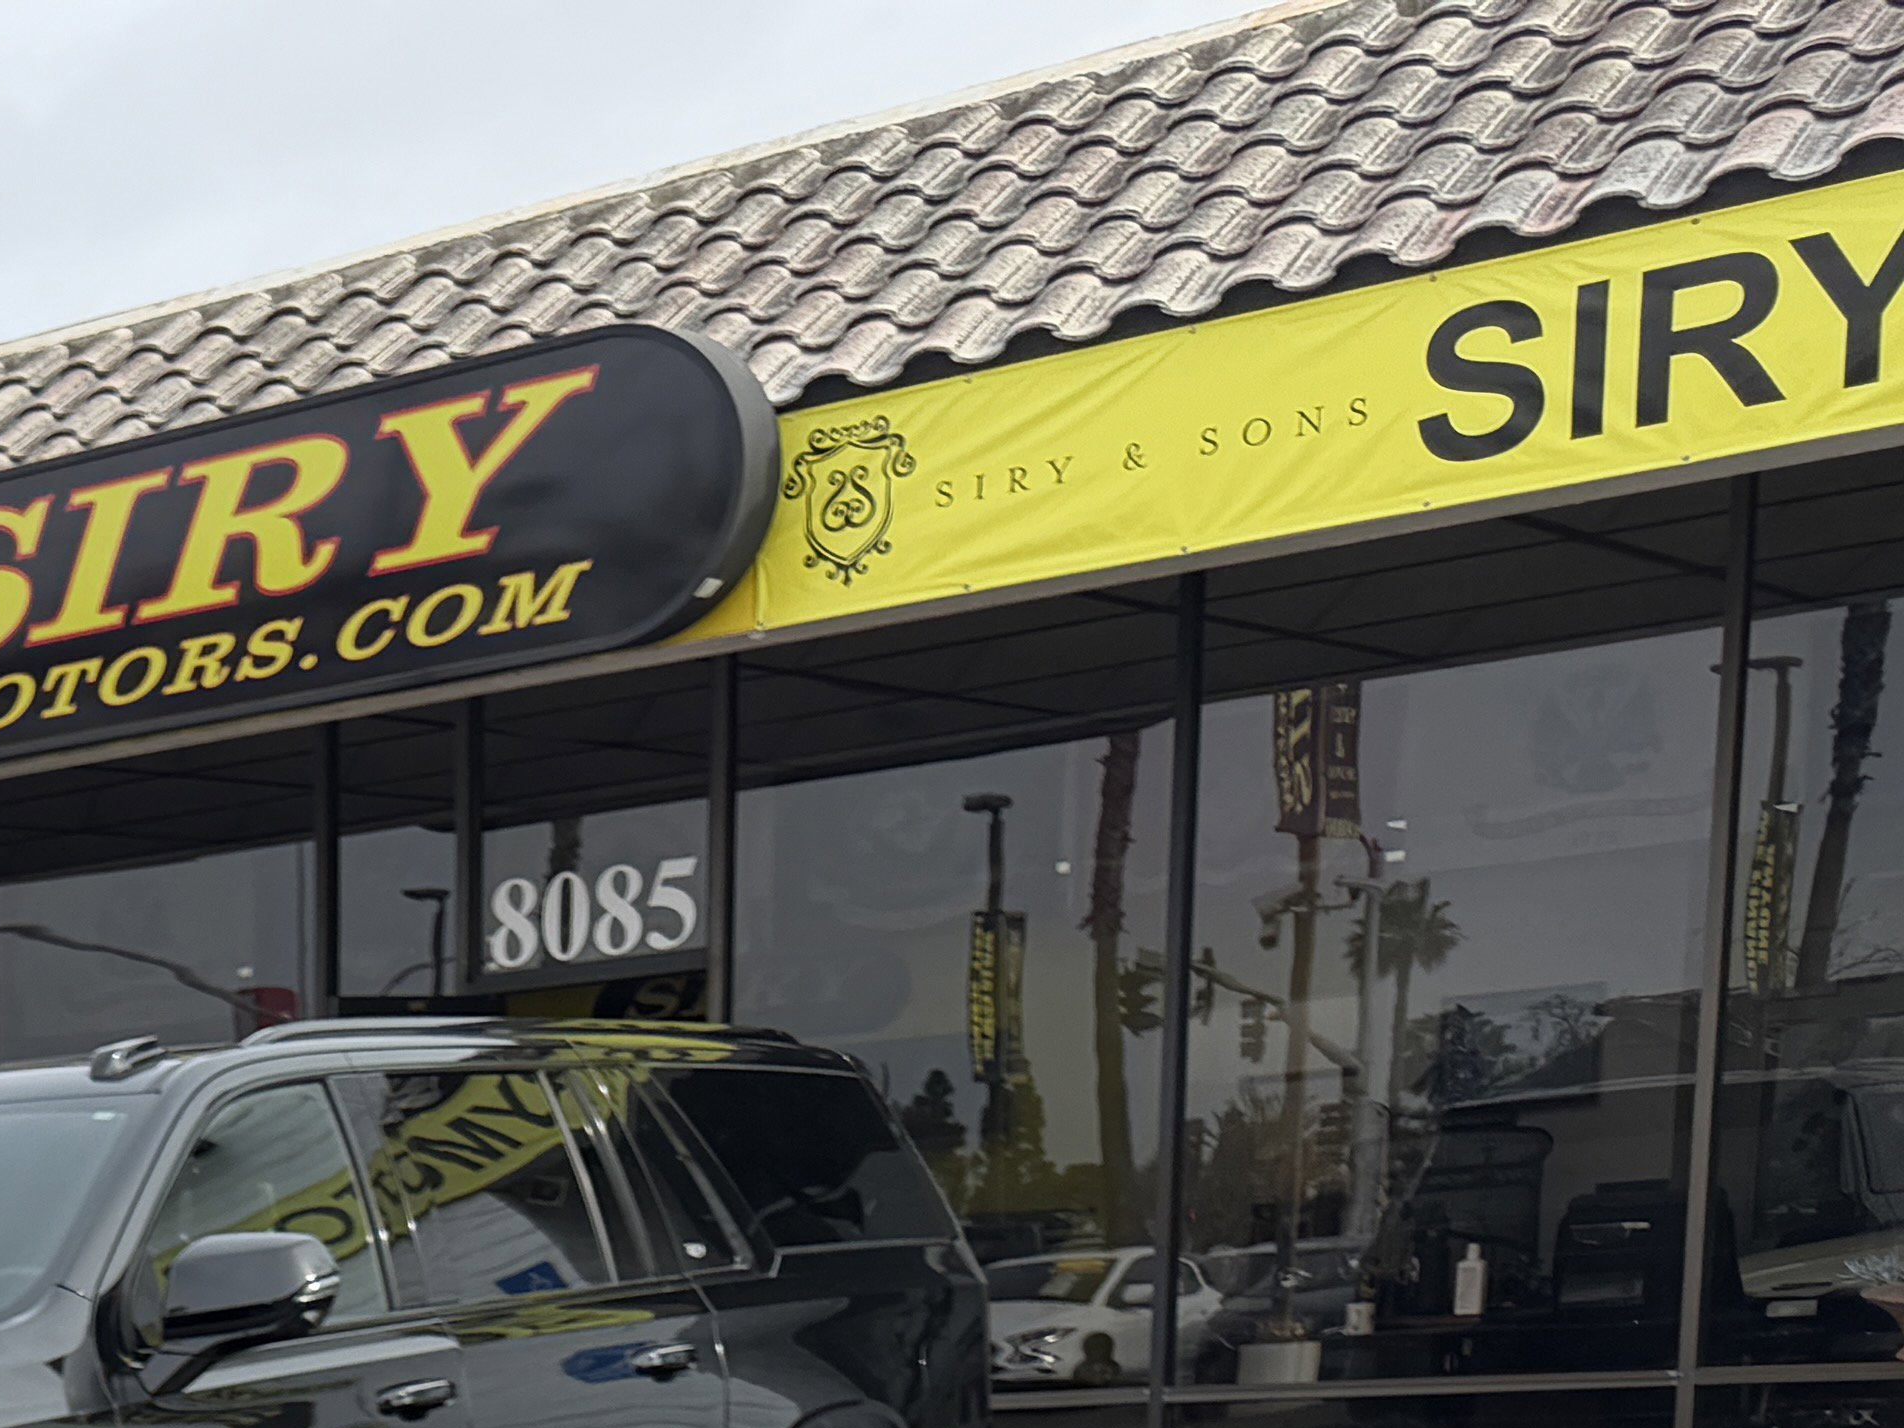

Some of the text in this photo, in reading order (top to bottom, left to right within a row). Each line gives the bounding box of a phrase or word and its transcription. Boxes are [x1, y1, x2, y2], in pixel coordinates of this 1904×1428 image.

[1417, 224, 1904, 462] SIRY
[934, 397, 1370, 508] SIRY & SONS
[486, 855, 698, 972] 8085
